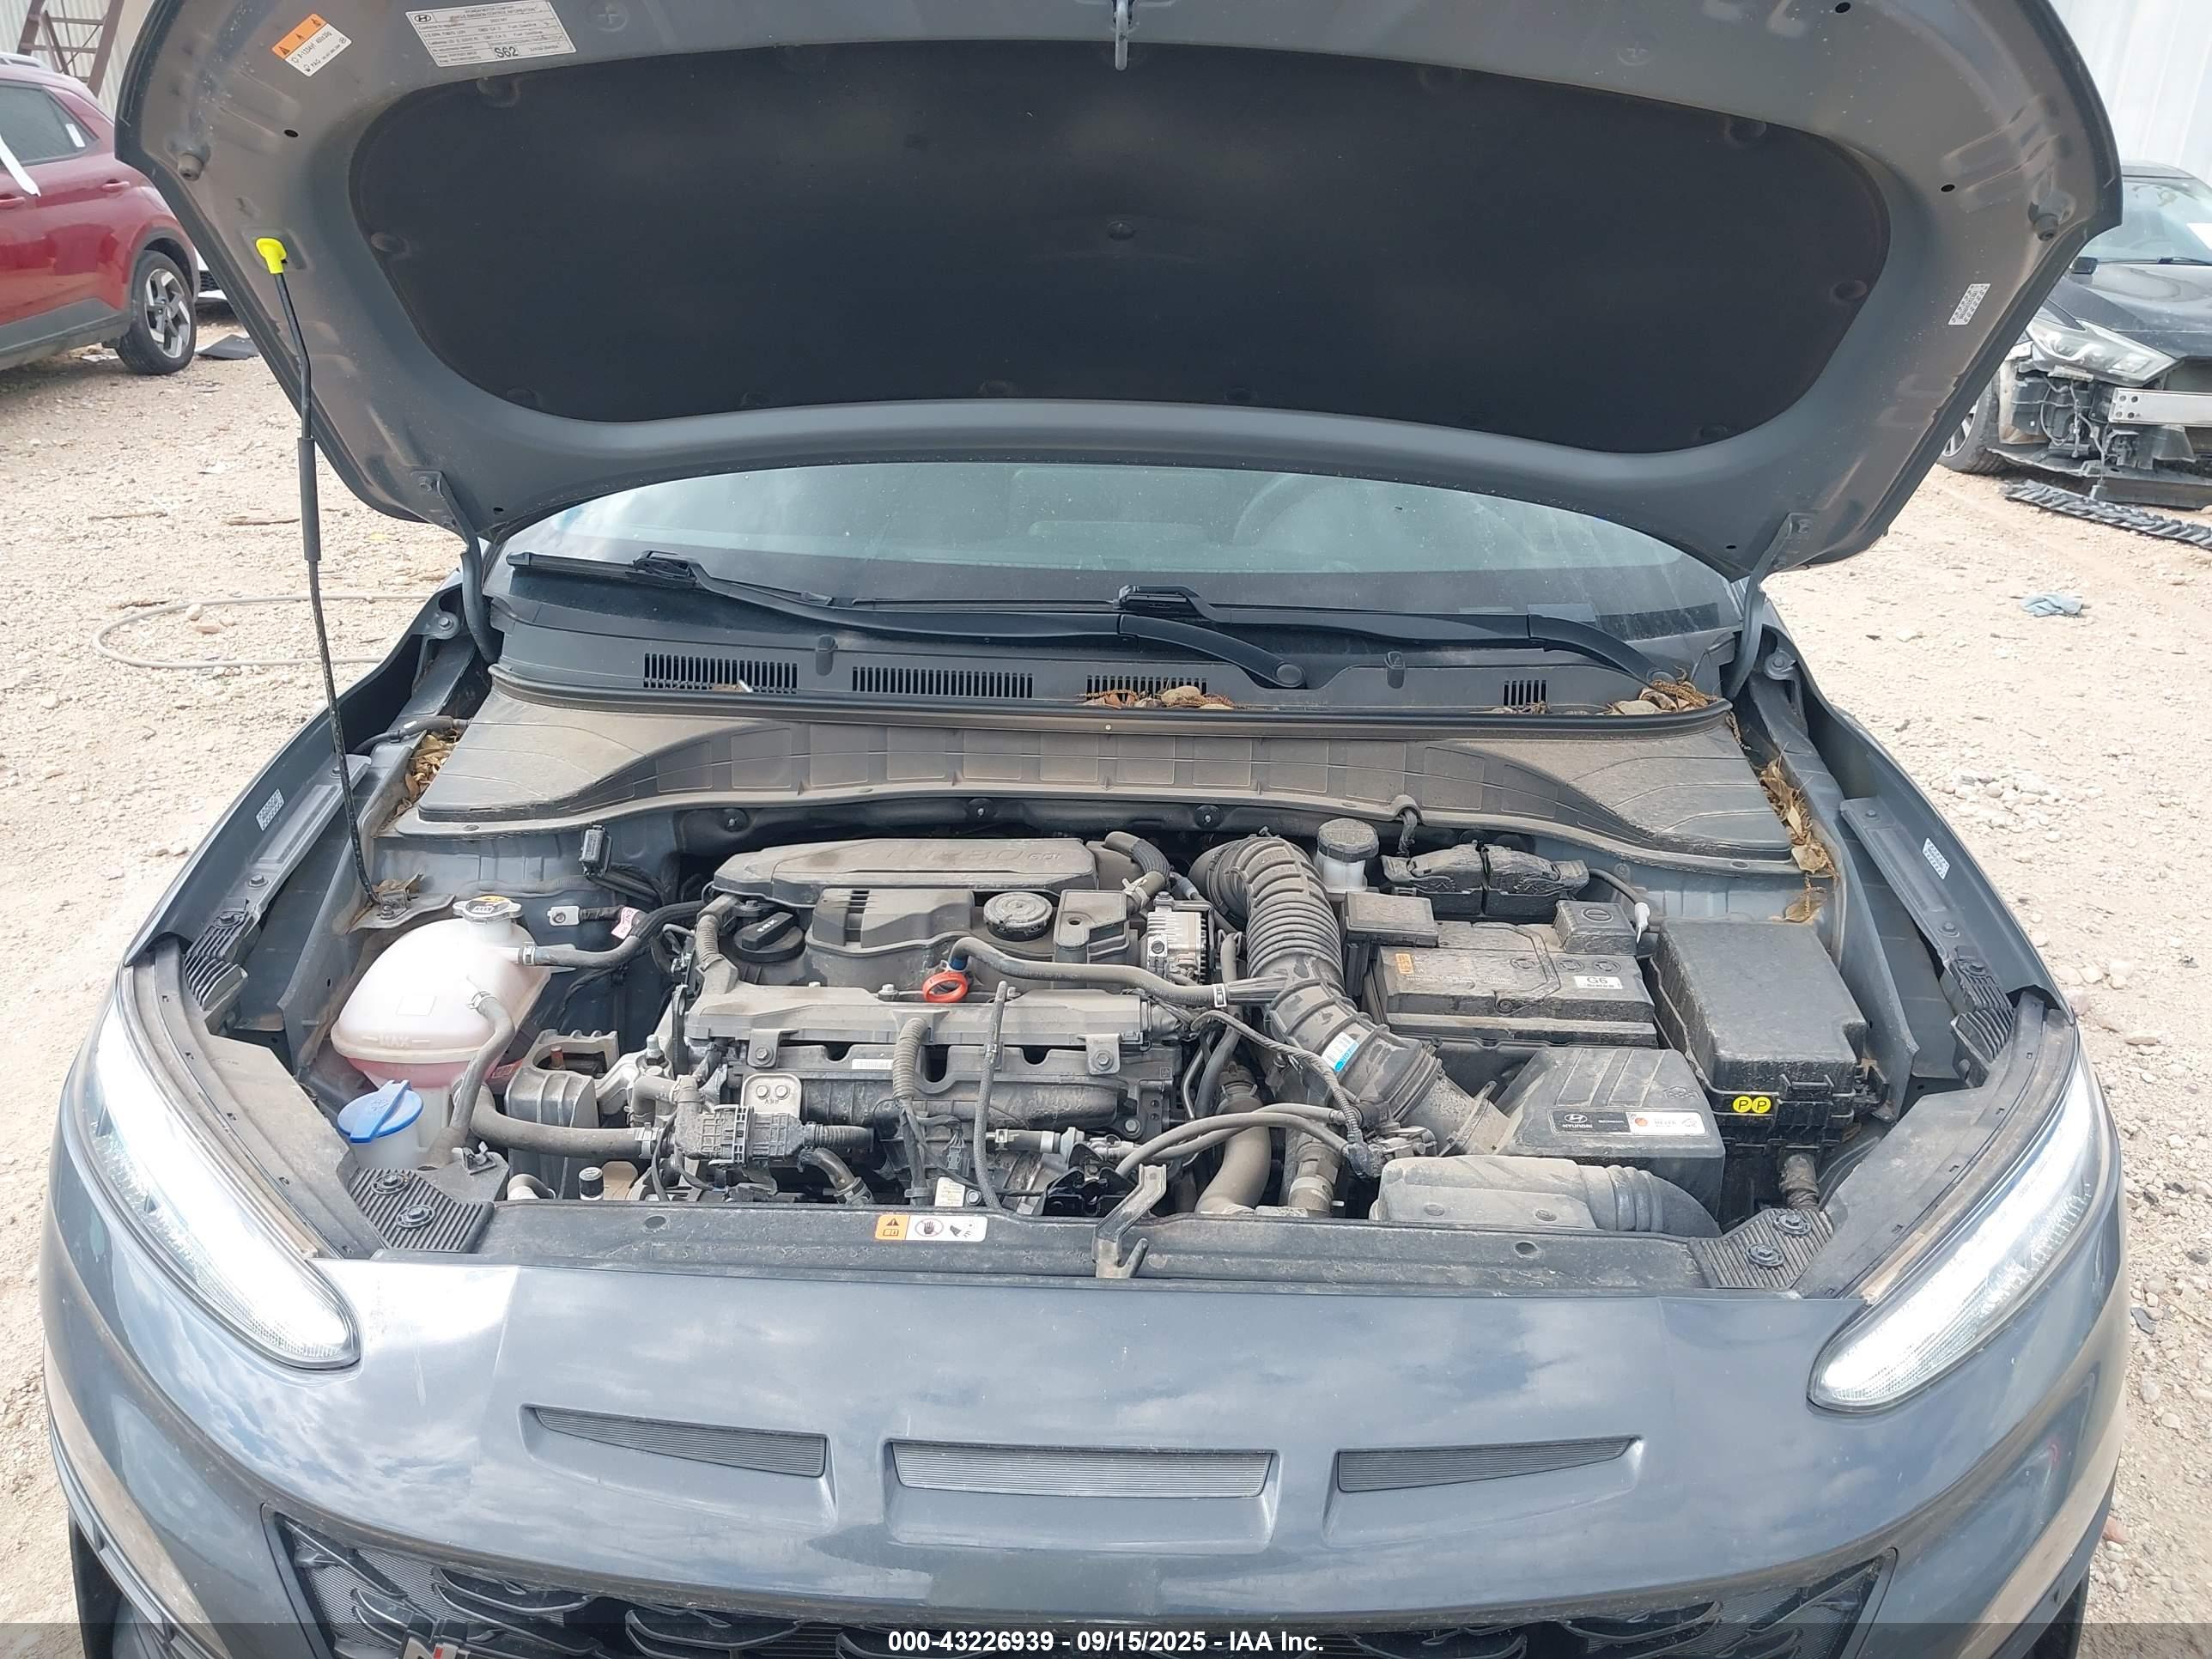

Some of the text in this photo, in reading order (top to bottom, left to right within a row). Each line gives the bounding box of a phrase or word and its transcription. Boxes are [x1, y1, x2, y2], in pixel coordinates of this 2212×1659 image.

[494, 46, 519, 58] S62
[1586, 976, 1608, 985] G6
[1738, 1099, 1767, 1111] P P
